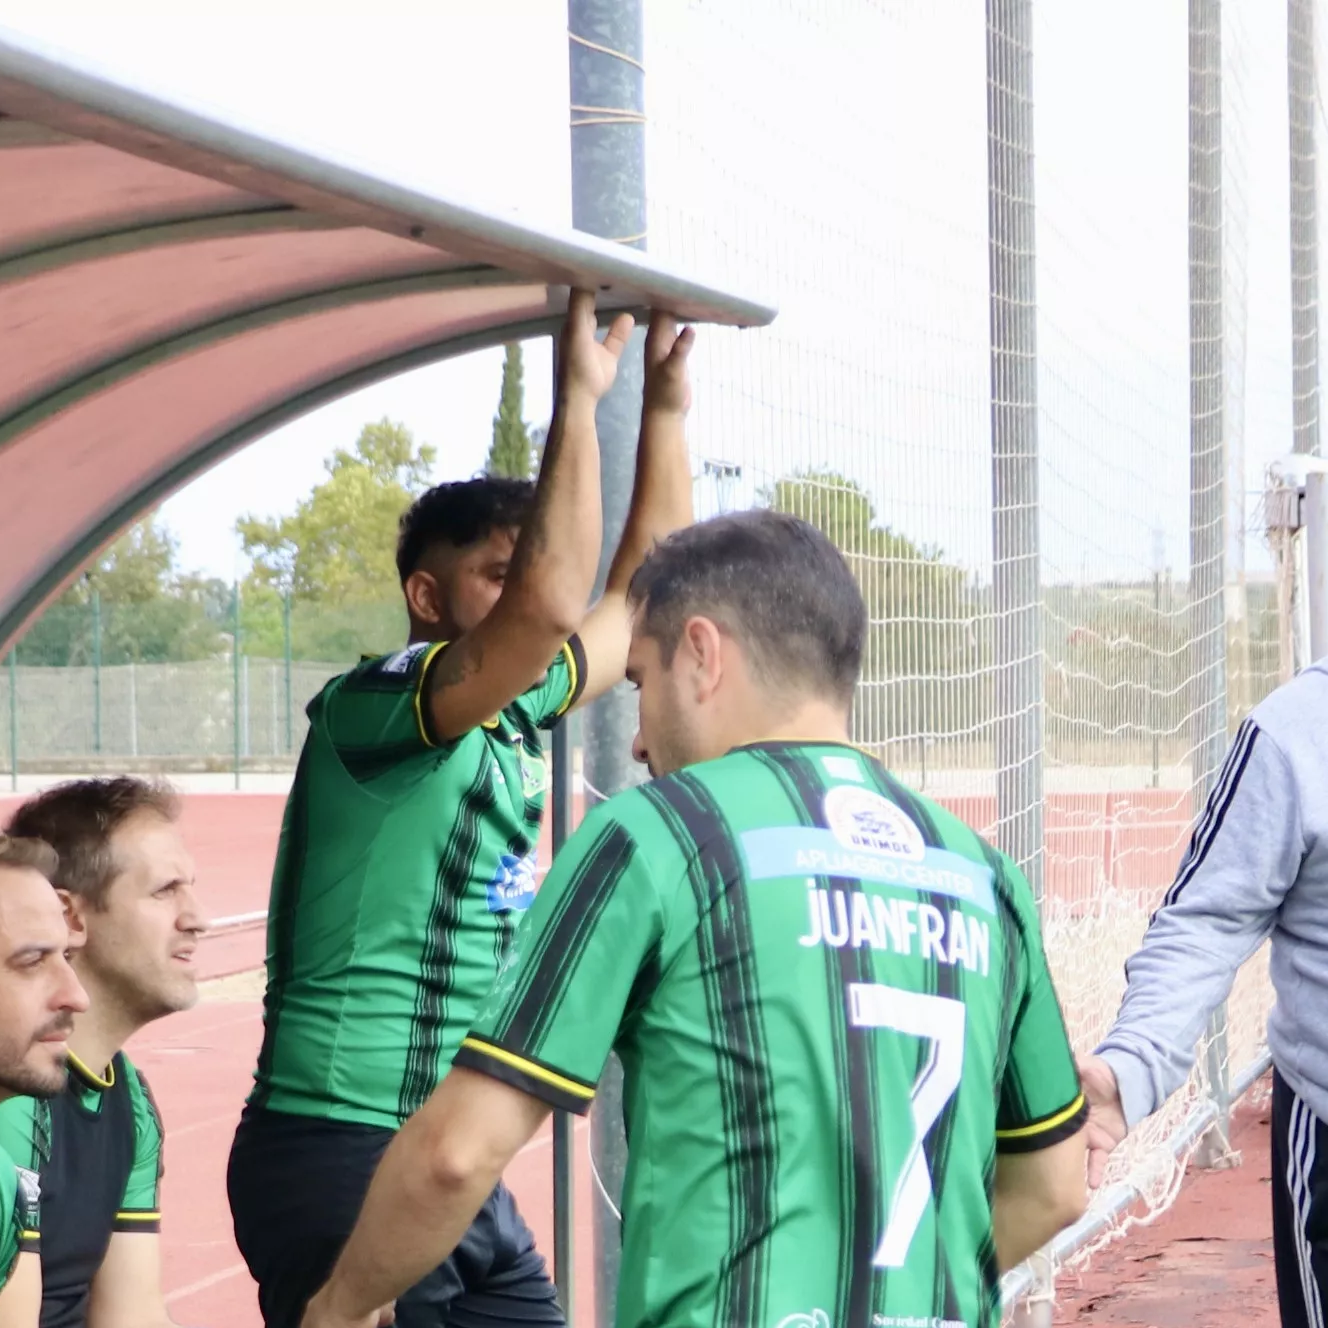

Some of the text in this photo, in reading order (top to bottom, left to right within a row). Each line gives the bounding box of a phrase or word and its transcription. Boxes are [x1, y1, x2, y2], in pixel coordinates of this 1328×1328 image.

[901, 864, 975, 898] CENTER
[849, 982, 966, 1267] 7
[873, 1313, 929, 1328] Sociedad
